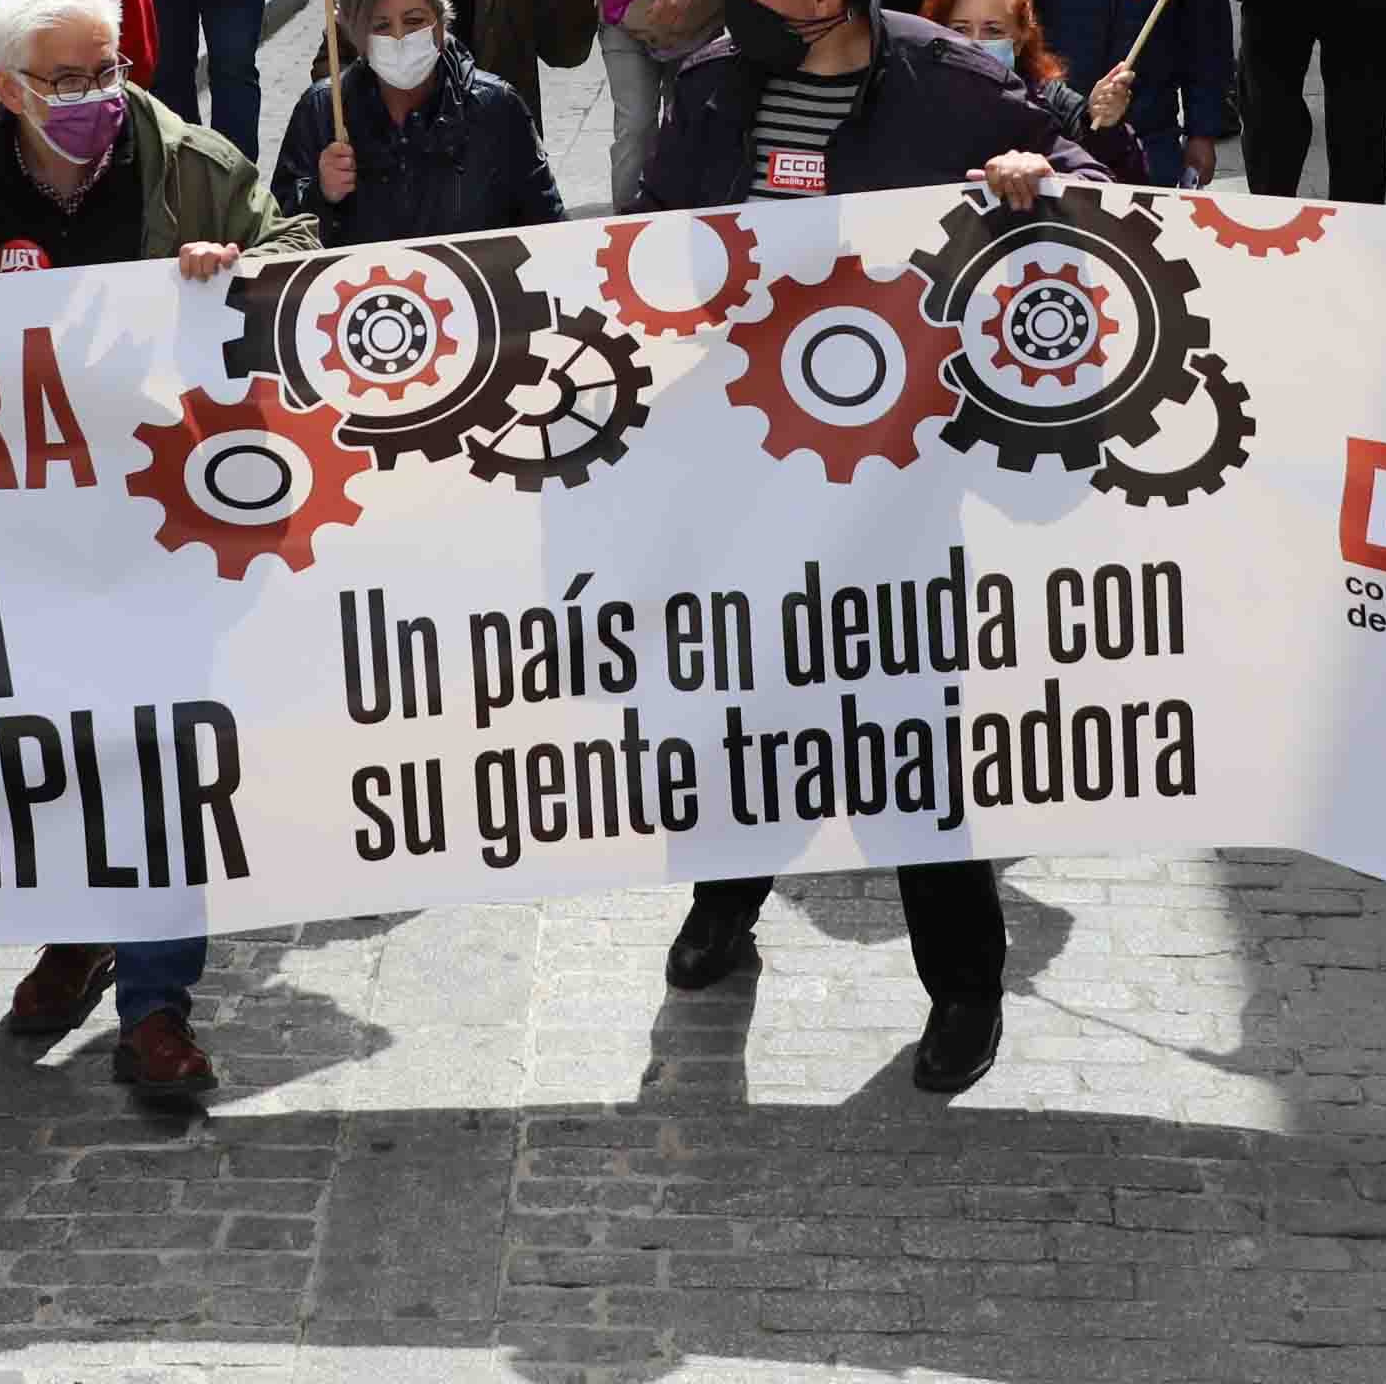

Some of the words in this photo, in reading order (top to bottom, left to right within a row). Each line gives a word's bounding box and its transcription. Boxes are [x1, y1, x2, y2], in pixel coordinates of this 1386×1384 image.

[1, 248, 39, 267] UGT
[339, 586, 442, 725] Un
[468, 572, 638, 729] país
[665, 588, 755, 694] en
[781, 545, 1018, 690] deuda
[1045, 560, 1186, 666] con
[351, 749, 447, 863] su
[474, 706, 700, 870] gente
[722, 677, 1197, 832] trabajadora
